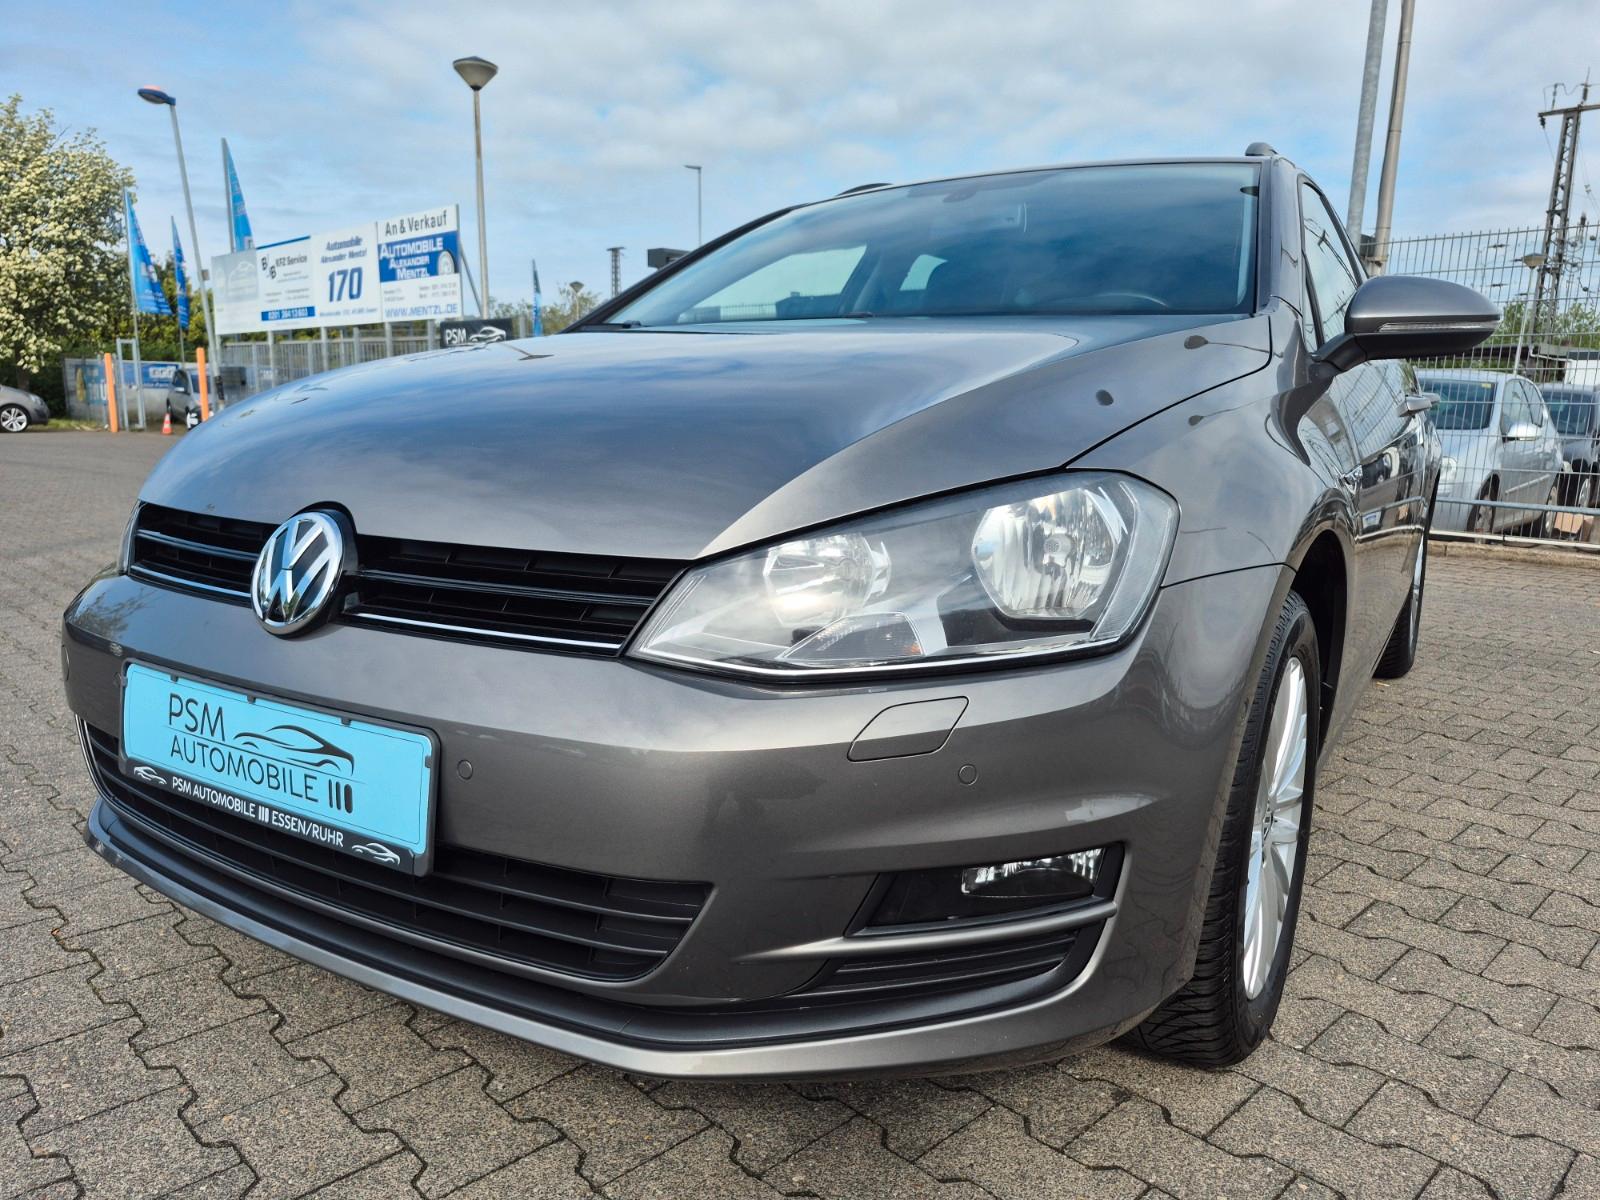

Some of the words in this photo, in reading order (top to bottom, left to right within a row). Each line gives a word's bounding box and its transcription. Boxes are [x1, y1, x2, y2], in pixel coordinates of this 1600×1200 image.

[385, 221, 398, 237] An
[400, 219, 406, 234] &
[407, 209, 447, 231] Verkauf
[287, 255, 307, 266] Service
[380, 237, 443, 260] AUTOMOBILE
[328, 266, 362, 302] 170
[445, 328, 467, 345] PSM
[169, 692, 225, 742] PSM
[170, 735, 319, 803] AUTOMOBILE
[172, 776, 192, 796] PSM
[193, 785, 256, 818] AUTOMOBILE
[272, 811, 344, 848] ESSEN/RUHR
